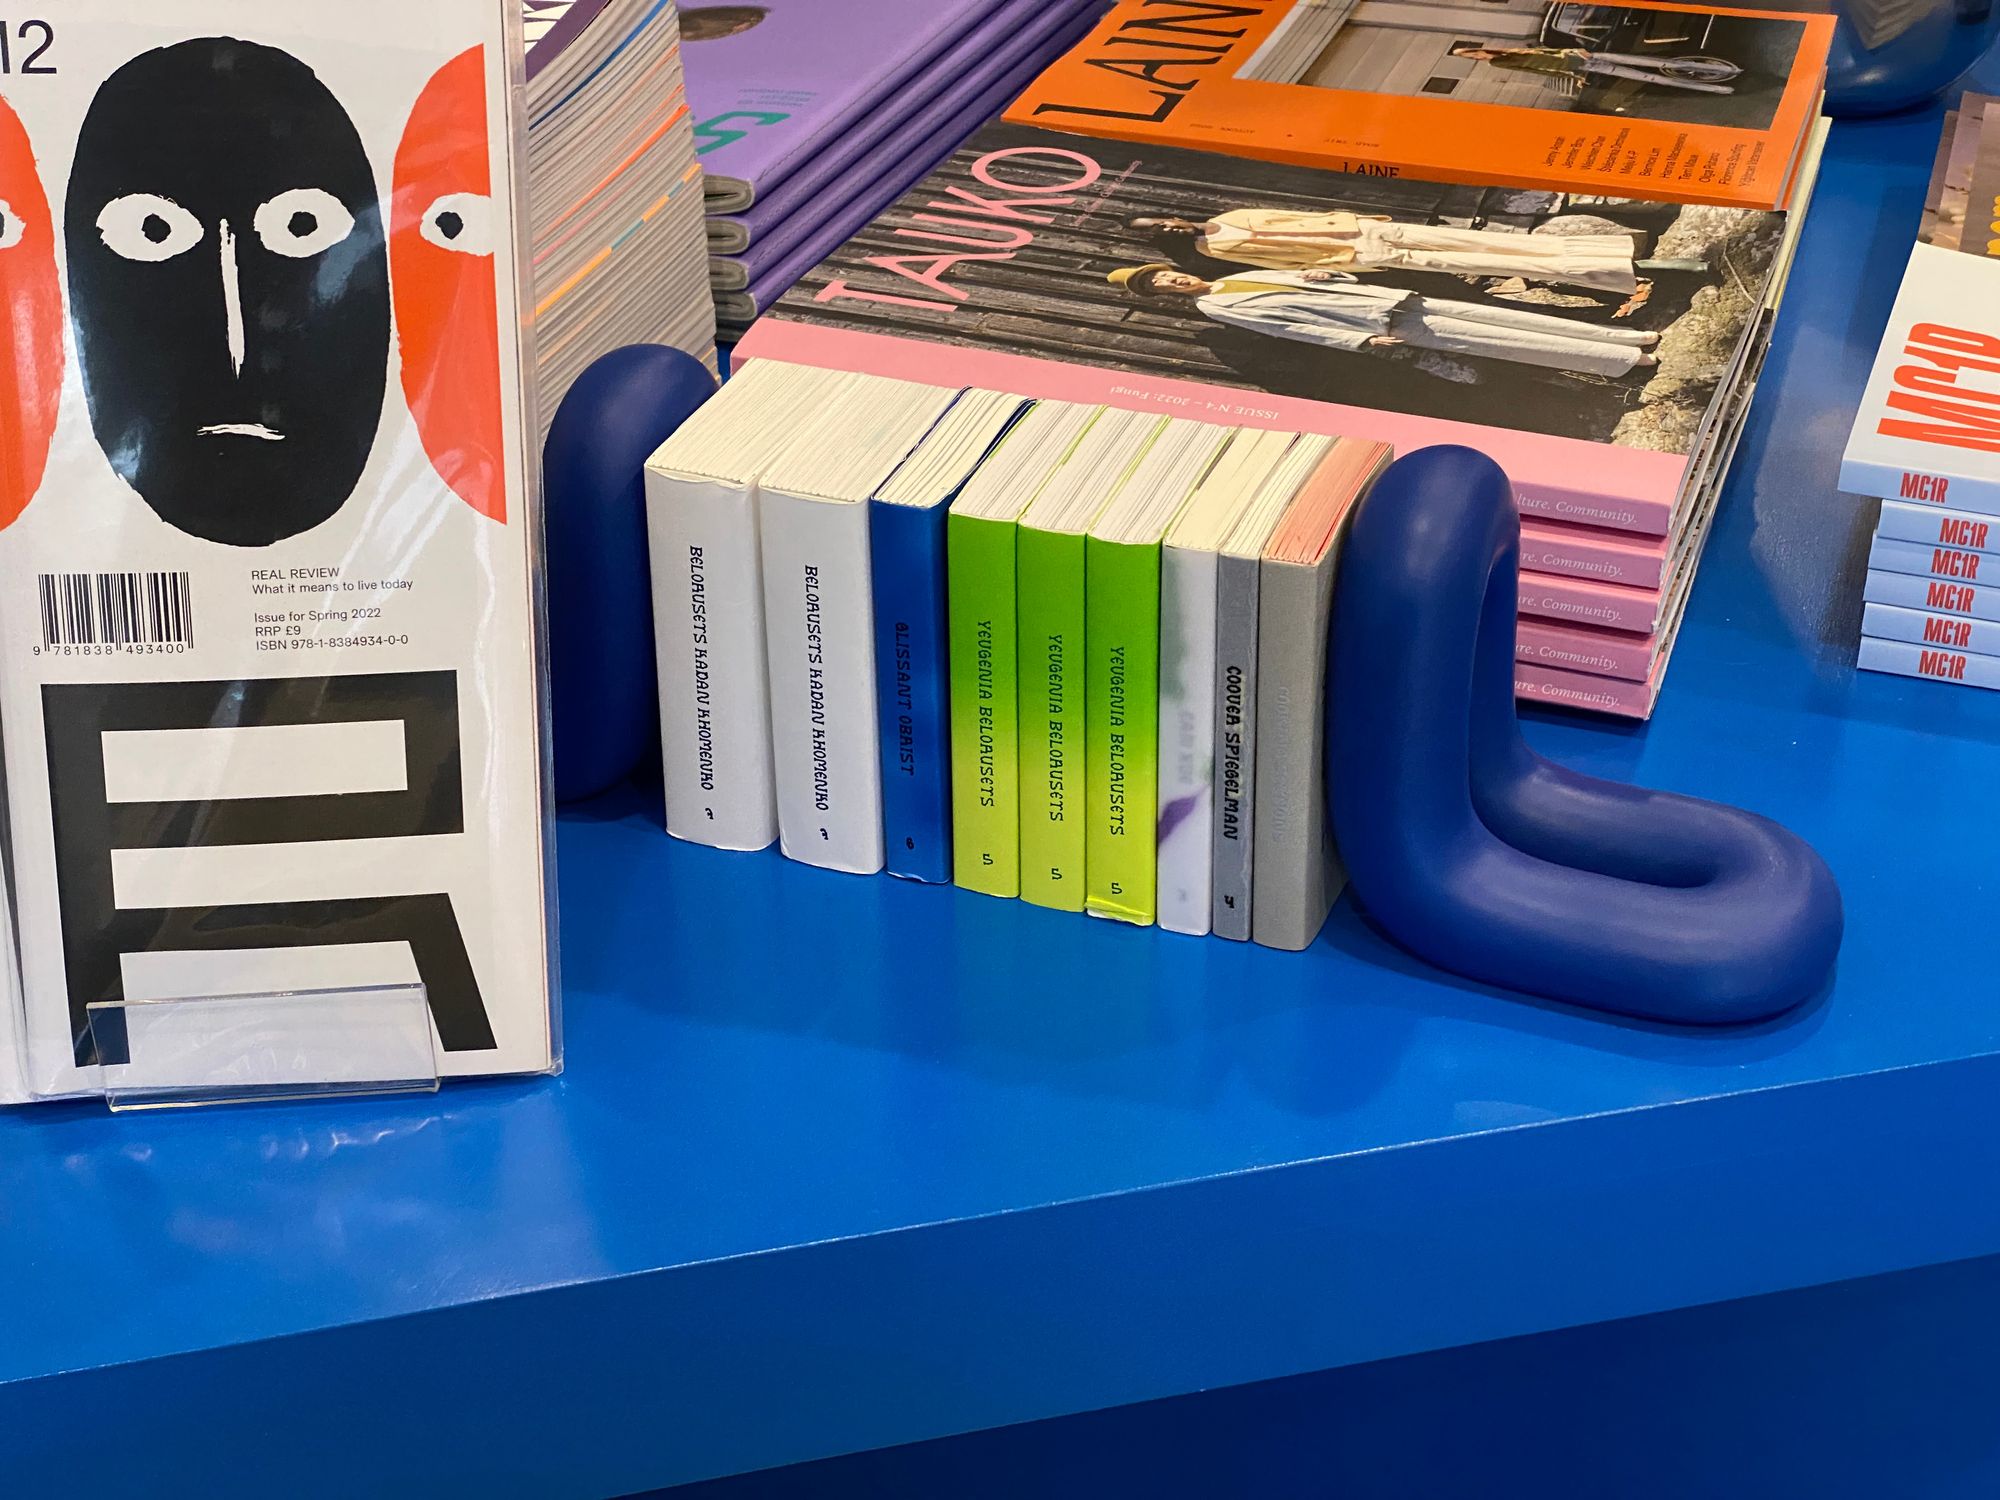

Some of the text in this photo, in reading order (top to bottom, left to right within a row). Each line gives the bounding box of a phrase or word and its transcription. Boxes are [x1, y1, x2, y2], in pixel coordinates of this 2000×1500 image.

[1032, 0, 1272, 122] LAIN
[1698, 169, 1715, 183] Olga
[813, 147, 1101, 312] TAUKO
[1111, 386, 1150, 400] Fungi
[1153, 394, 1191, 406] 2022:
[1234, 408, 1280, 421] ISSUE
[1900, 472, 1949, 503] MC1R
[1517, 493, 1637, 525] lture. Community.
[1939, 518, 1989, 548] MC1R
[251, 568, 339, 581] REAL REVIEW
[1542, 554, 1623, 577] Community.
[1931, 548, 1980, 579] MC1R
[252, 579, 413, 595] What it means to live today
[1926, 582, 1974, 612] MC1R
[254, 608, 381, 623] Issue for Spring 2022
[1542, 598, 1622, 621] Community.
[256, 626, 301, 637] RRP £9
[256, 635, 409, 650] ISBN 978-1-8384934-0-0
[1923, 617, 1971, 647] MC1R
[33, 644, 184, 656] 9 781838 493400
[1540, 647, 1618, 670] Community.
[695, 647, 710, 706] KADAN
[1919, 650, 1966, 680] MC1R
[810, 668, 825, 725] KADAN
[1542, 683, 1620, 707] Community.
[698, 707, 714, 790] KHOMENKO
[813, 728, 829, 811] KHOMENKO
[982, 852, 993, 866] 5
[1051, 867, 1062, 880] 5
[1111, 881, 1122, 895] 5
